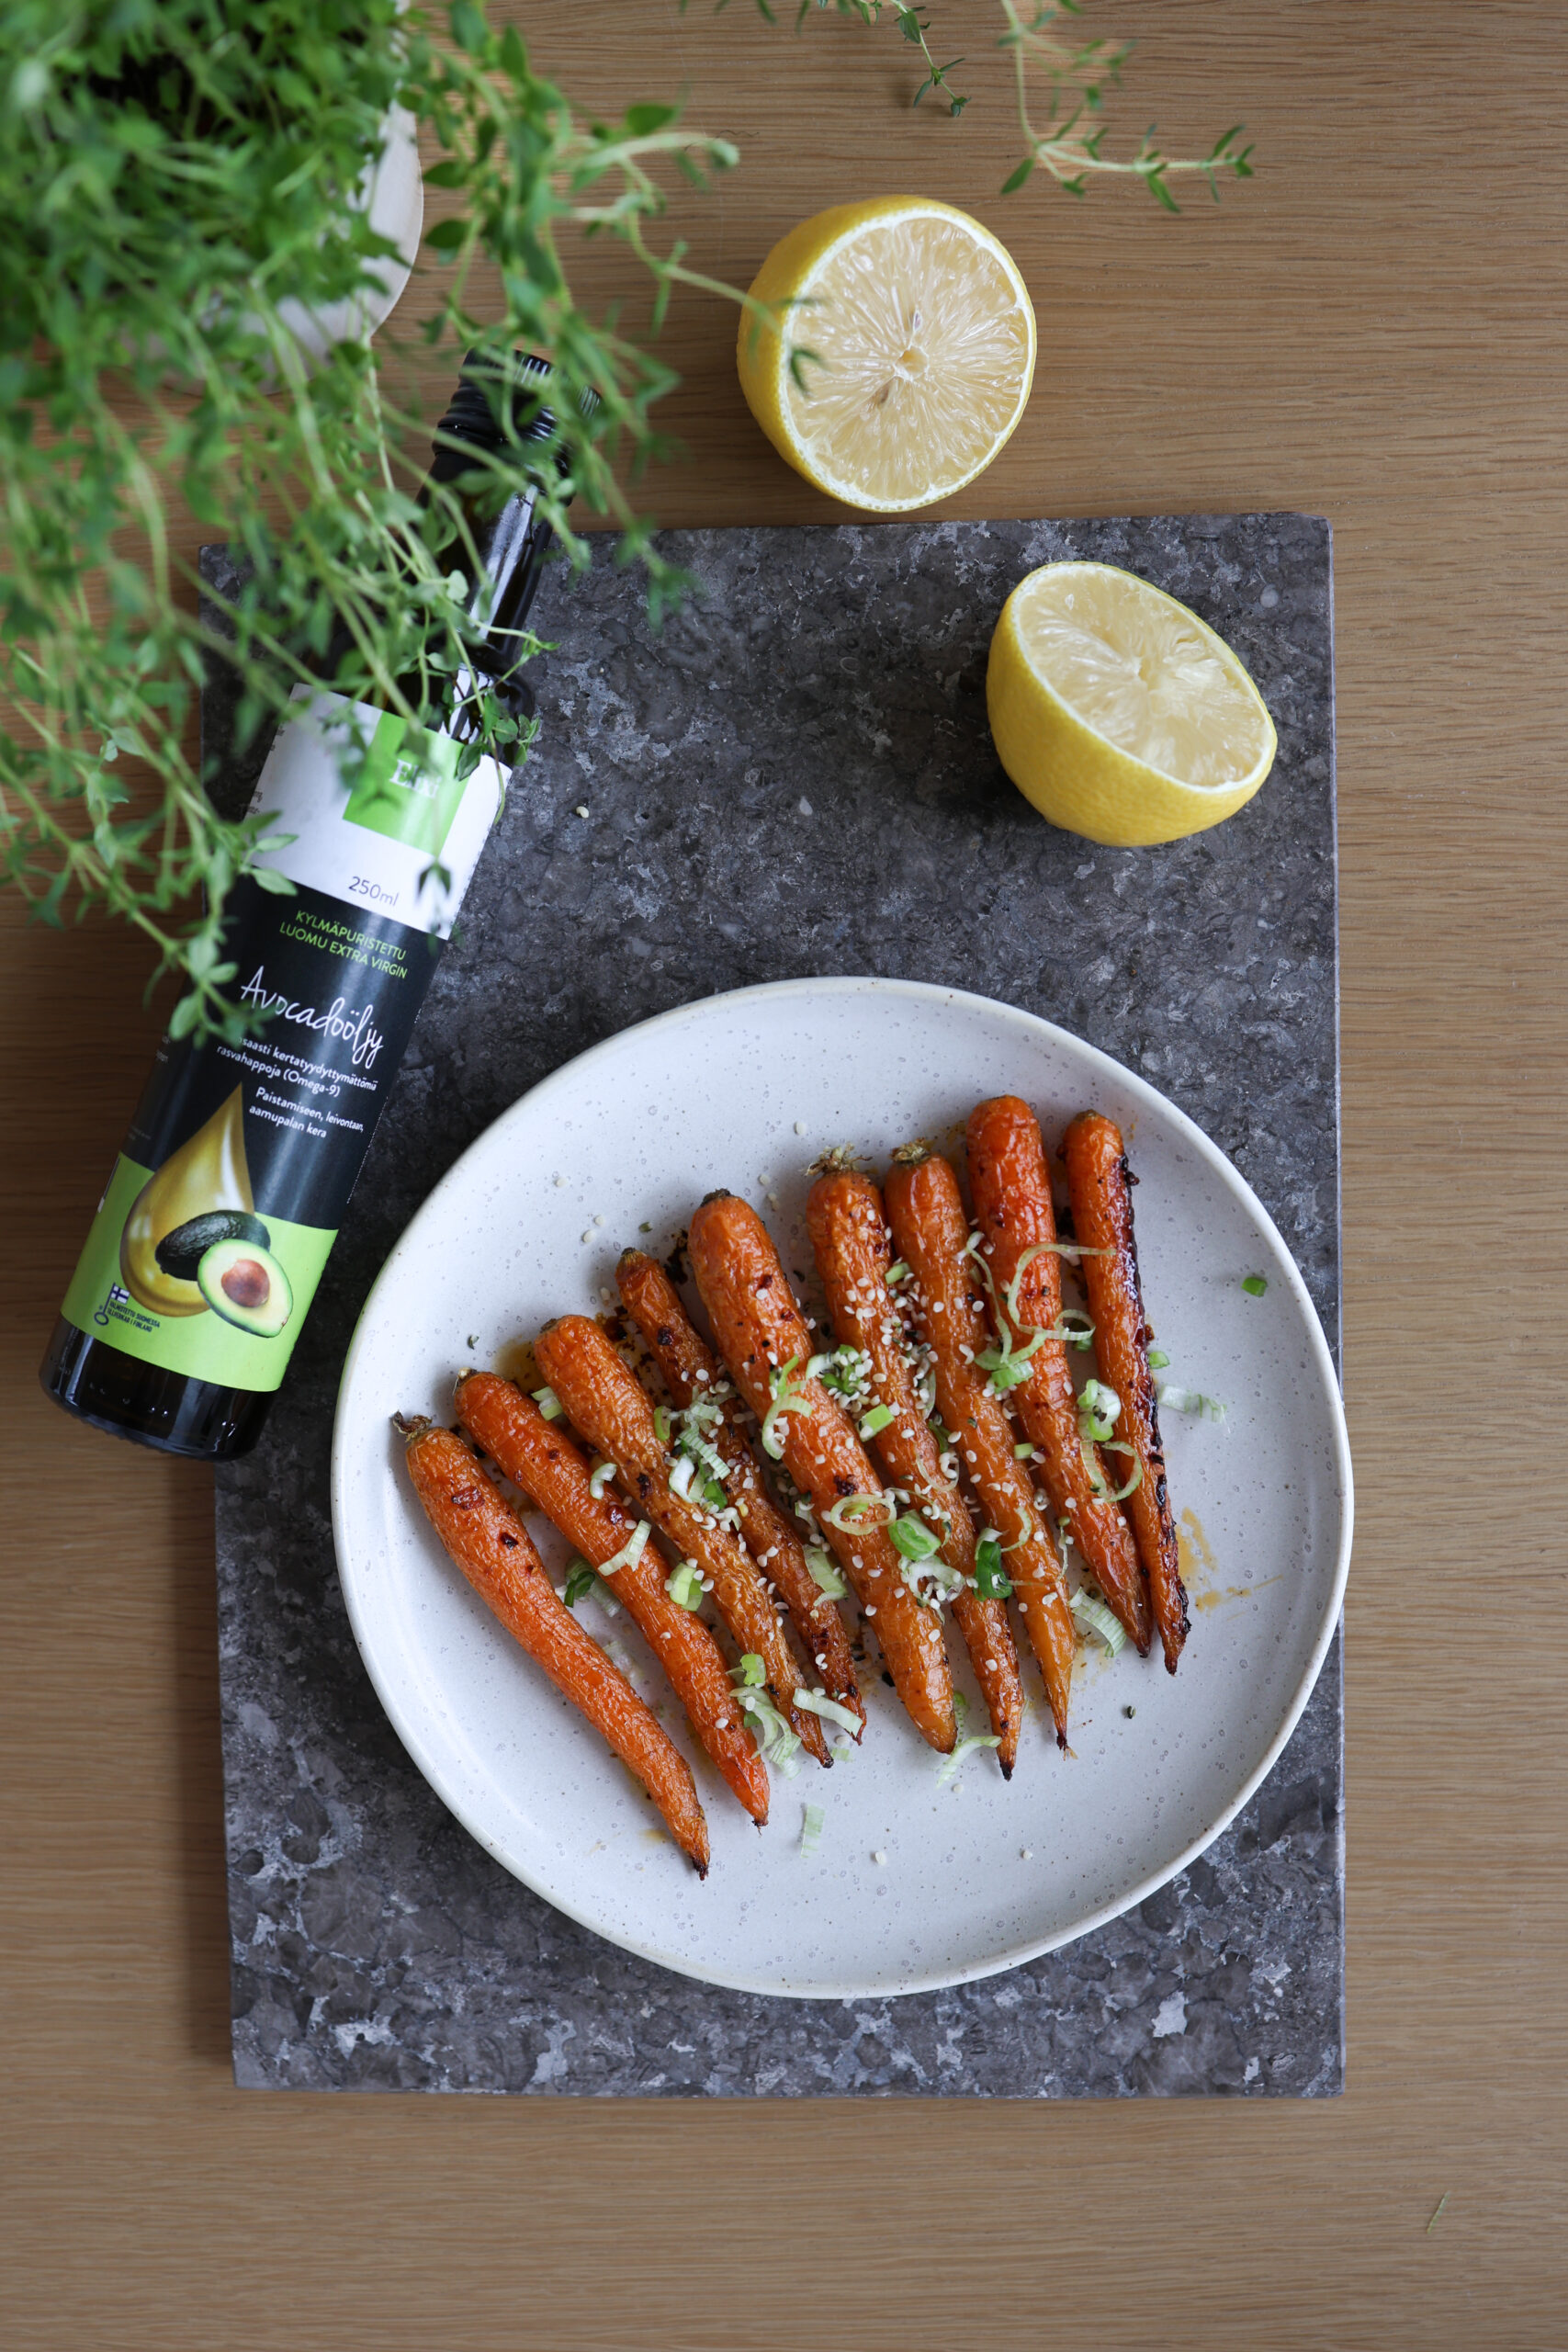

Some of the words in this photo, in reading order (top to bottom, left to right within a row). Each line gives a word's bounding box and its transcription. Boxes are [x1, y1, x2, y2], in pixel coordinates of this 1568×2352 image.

[348, 876, 400, 907] 250ml
[279, 922, 328, 949] LUOMU
[329, 941, 368, 966] EXTRA
[371, 956, 408, 979] VIRGIN
[296, 910, 407, 960] KYLMÄPURISTETTU
[241, 966, 384, 1069] Avocadoöljy
[217, 1045, 281, 1079] rasvahappoja
[283, 1069, 341, 1097] (Omega-9)
[273, 1046, 378, 1091] kertatyydyttymättömiä
[249, 1105, 305, 1132] aamupalan
[307, 1123, 327, 1138] kera
[256, 1086, 323, 1121] Paistamiseen,
